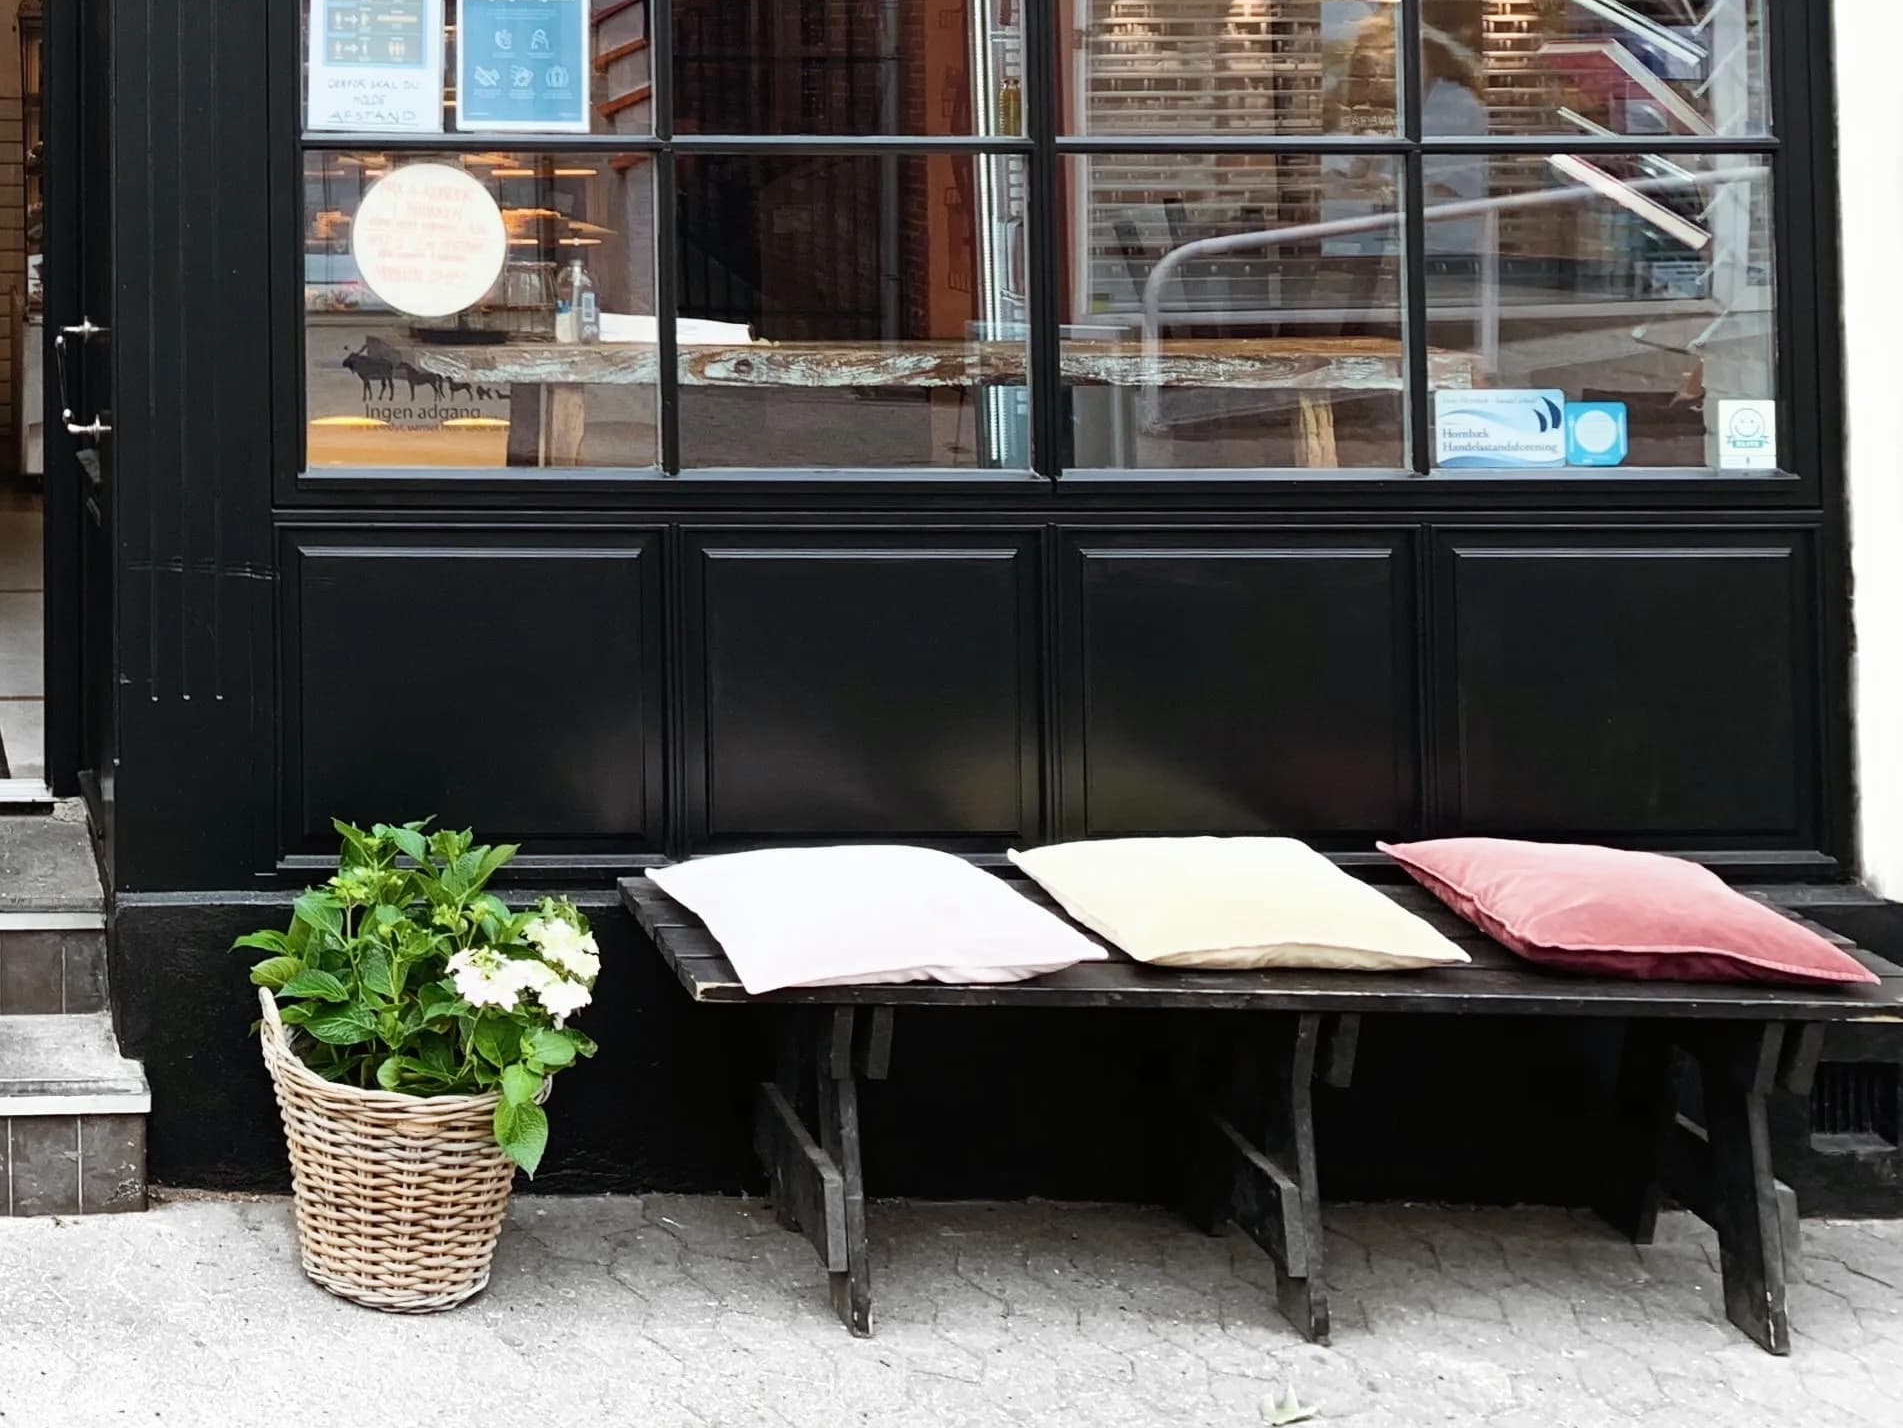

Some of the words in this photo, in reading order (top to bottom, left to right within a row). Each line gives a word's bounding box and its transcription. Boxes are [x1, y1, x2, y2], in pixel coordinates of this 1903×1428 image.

[328, 110, 417, 123] AFSTAND
[365, 404, 413, 421] Ingen
[418, 404, 481, 420] adgang
[1442, 428, 1489, 439] Hornbæk
